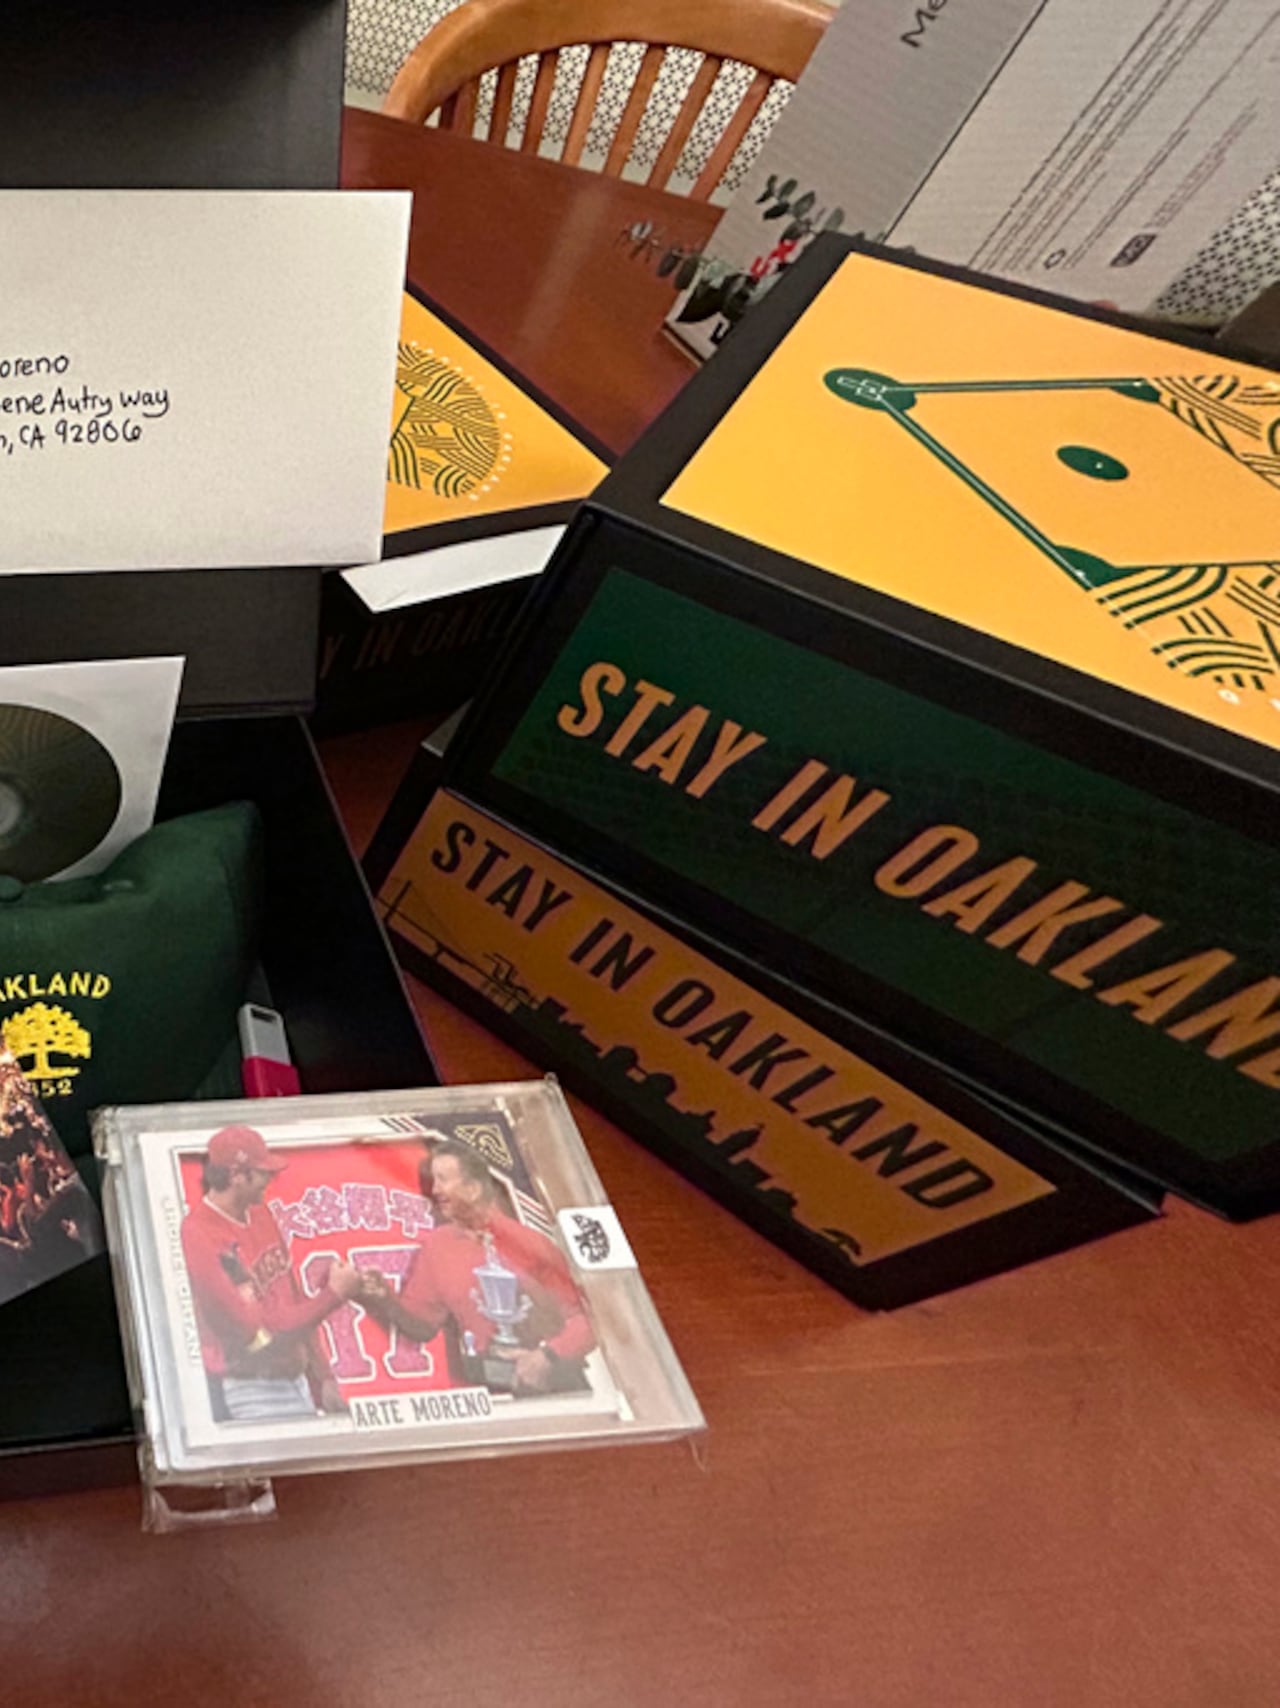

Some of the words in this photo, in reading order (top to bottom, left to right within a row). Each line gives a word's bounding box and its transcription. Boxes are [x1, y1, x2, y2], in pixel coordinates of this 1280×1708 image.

[50, 385, 113, 418] Autry
[19, 424, 46, 449] CA
[55, 419, 142, 444] 92806
[557, 661, 767, 800] STAY
[750, 759, 891, 861] IN
[431, 821, 572, 934] STAY
[569, 917, 658, 991] IN
[651, 979, 997, 1210] OAKLAND
[354, 1399, 404, 1427] ARTE
[409, 1391, 493, 1422] MORENO
